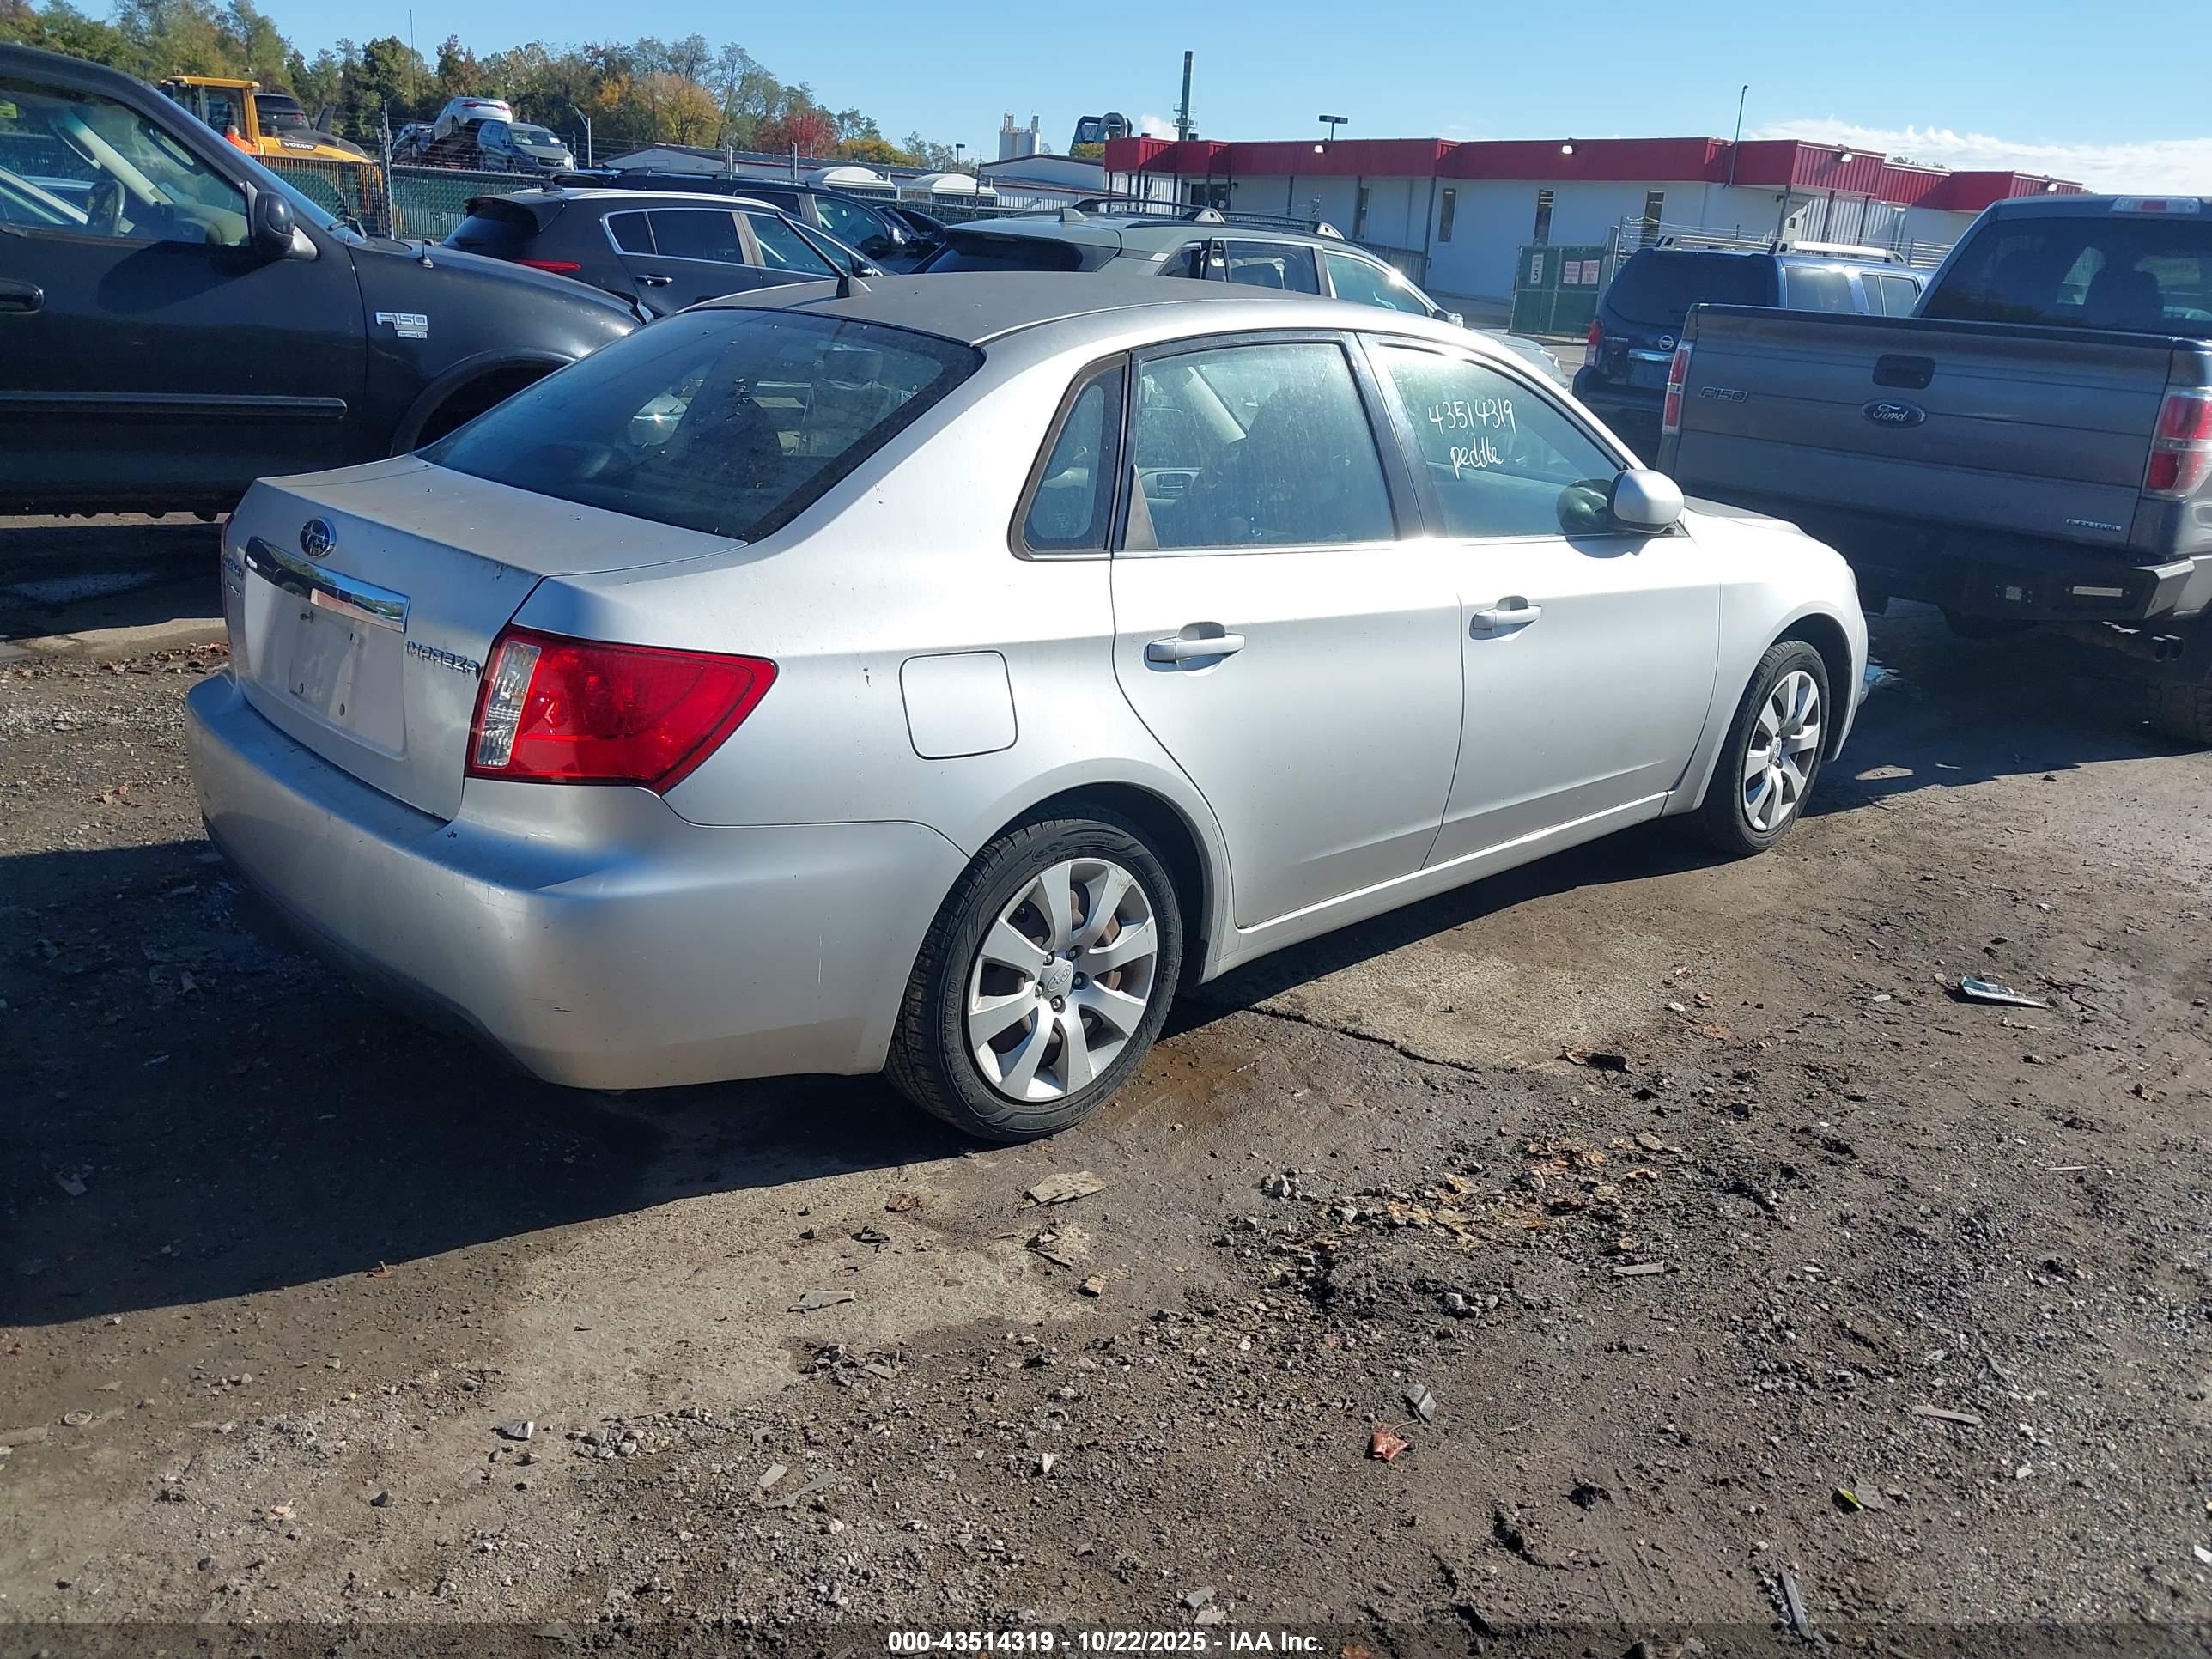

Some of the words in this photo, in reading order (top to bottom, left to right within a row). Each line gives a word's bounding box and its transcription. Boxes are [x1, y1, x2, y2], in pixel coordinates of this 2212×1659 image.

[1533, 270, 1539, 281] 5
[1428, 398, 1516, 435] 43514319
[1873, 404, 1909, 422] Ford
[1449, 436, 1504, 481] peddle
[405, 640, 481, 678] IMPREZA
